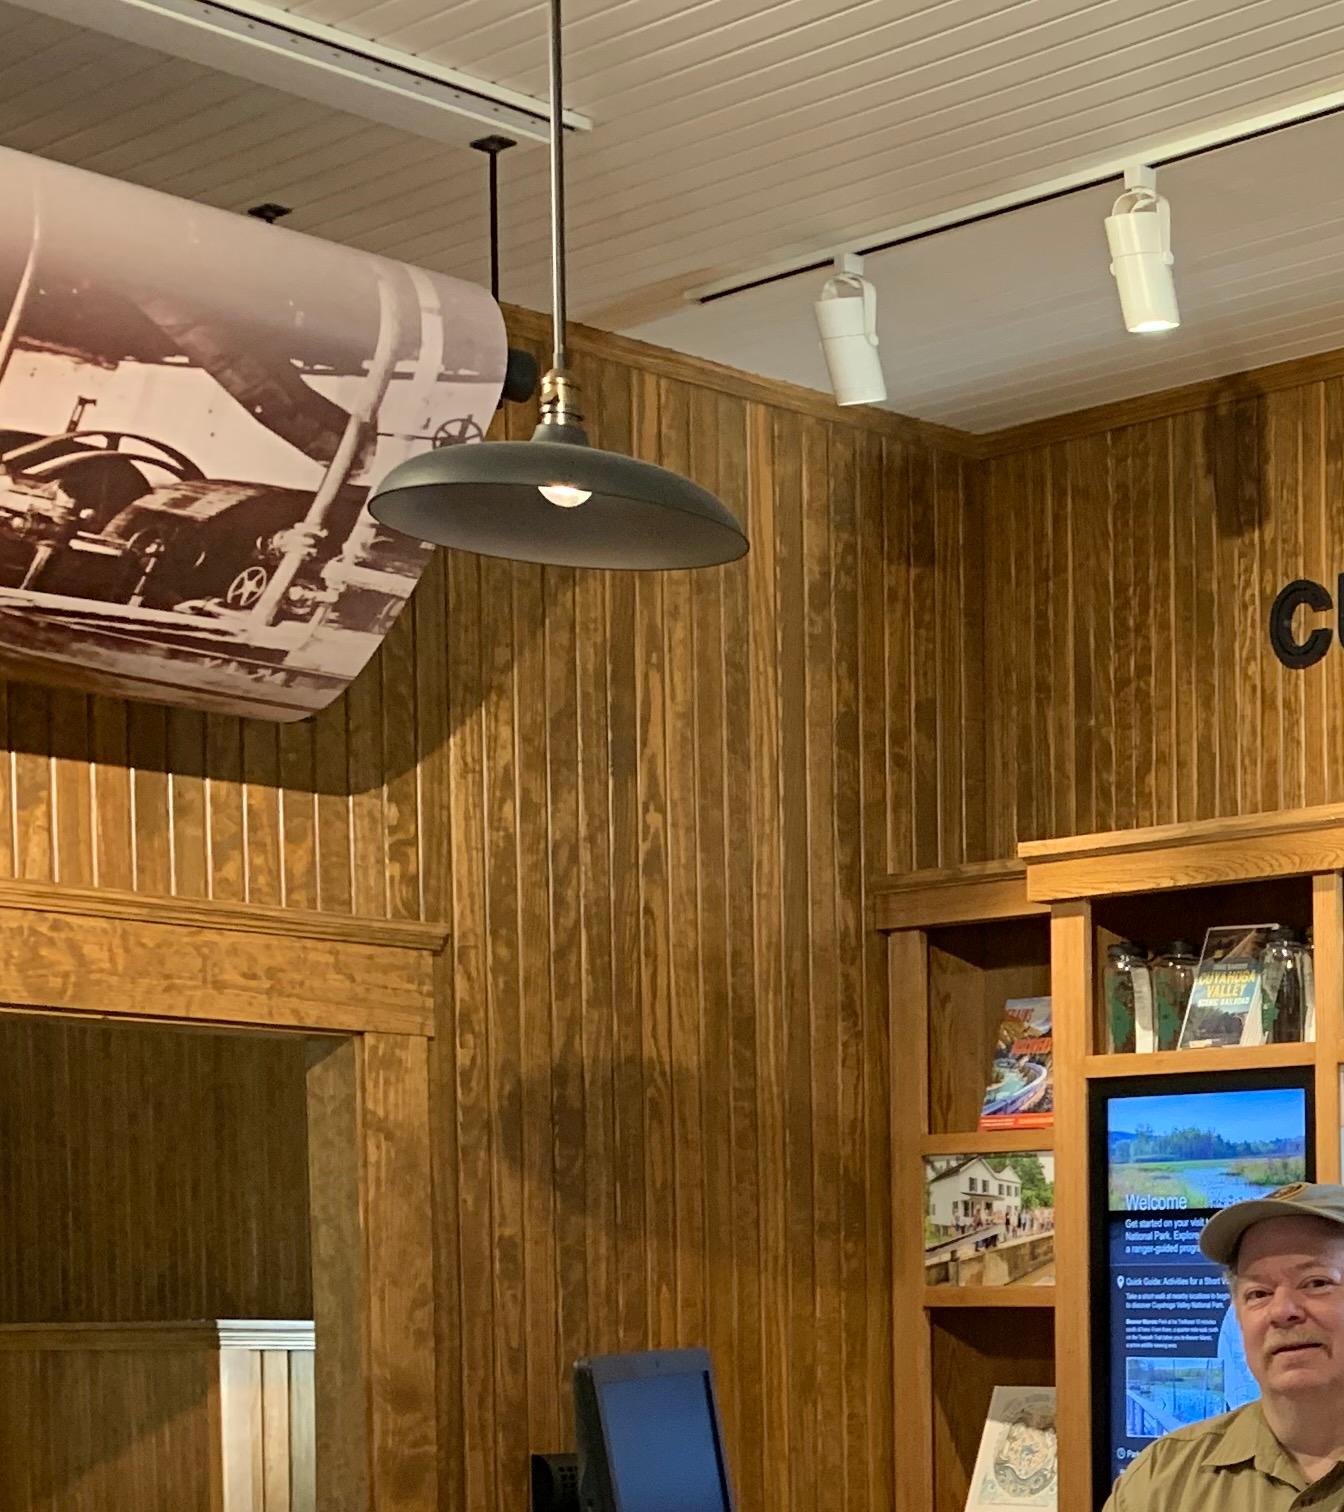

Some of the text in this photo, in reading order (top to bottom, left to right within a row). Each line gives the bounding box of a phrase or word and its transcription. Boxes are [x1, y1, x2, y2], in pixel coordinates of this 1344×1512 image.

[1208, 983, 1246, 998] VALLEY
[1125, 1194, 1188, 1211] Welcome
[1125, 1219, 1138, 1228] Get
[1139, 1218, 1162, 1228] started
[1163, 1220, 1173, 1228] on
[1174, 1220, 1189, 1229] your
[1125, 1231, 1153, 1240] National
